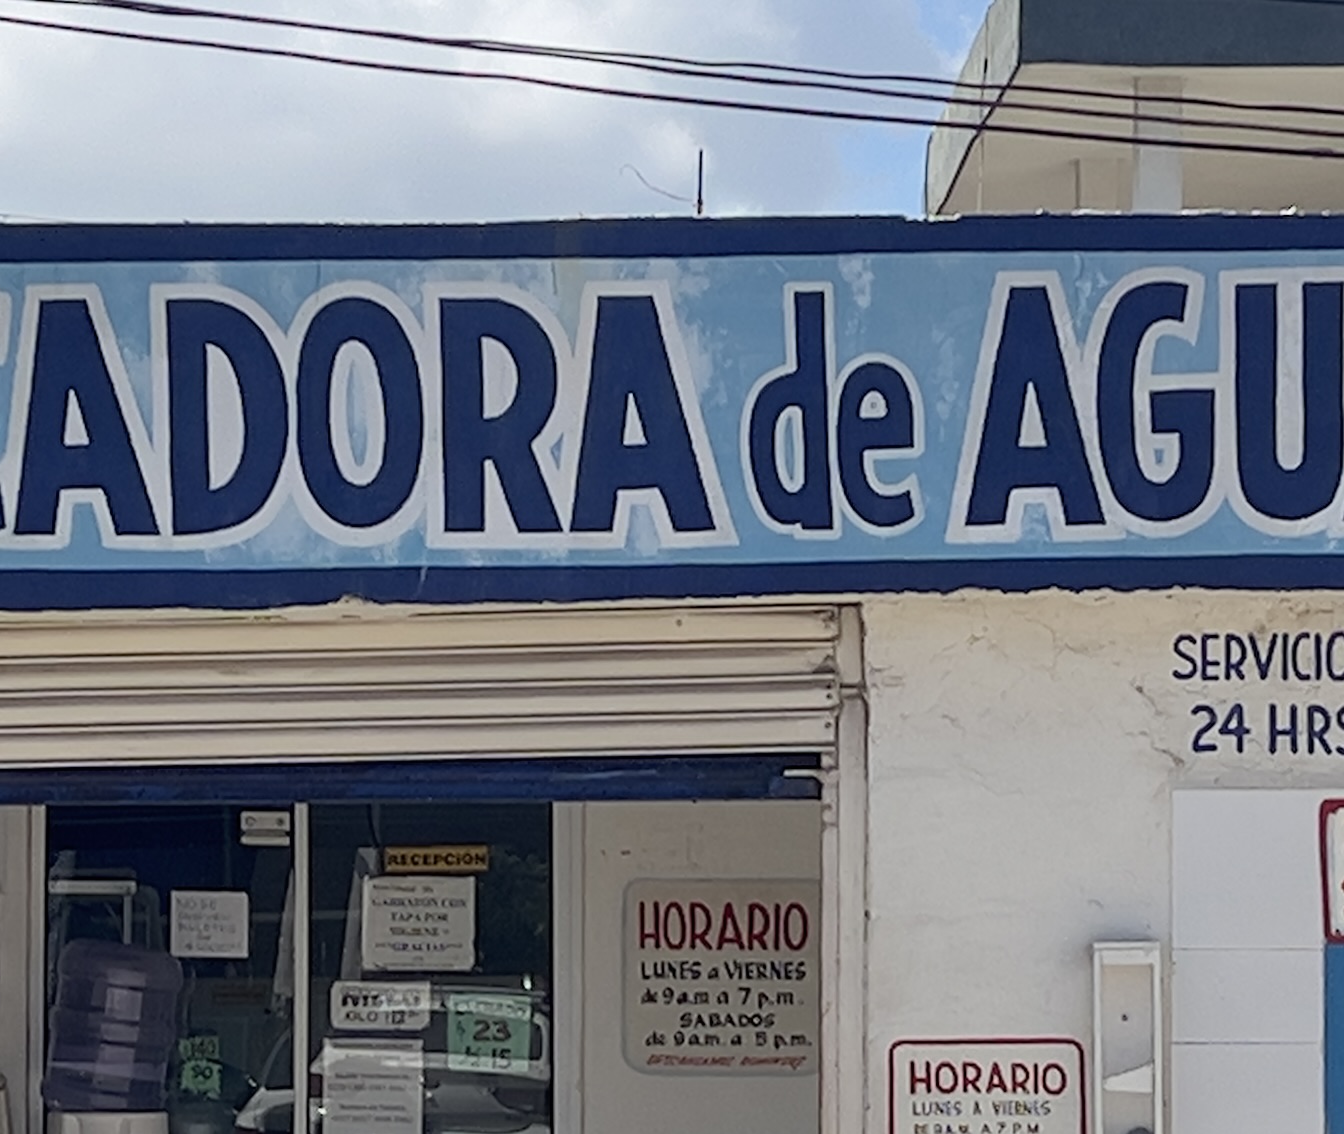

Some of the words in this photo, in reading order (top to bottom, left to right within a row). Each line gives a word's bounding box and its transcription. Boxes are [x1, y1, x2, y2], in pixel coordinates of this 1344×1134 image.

[747, 288, 918, 531] de
[1190, 703, 1252, 755] 24
[639, 900, 809, 951] HORARIO
[641, 961, 702, 980] LUNES
[723, 960, 807, 981] VIERNES
[472, 1018, 512, 1042] 23
[679, 1011, 776, 1029] SABADOS
[909, 1060, 1068, 1096] HORARIO
[912, 1100, 963, 1117] LUNES
[991, 1100, 1052, 1117] VIERNES
